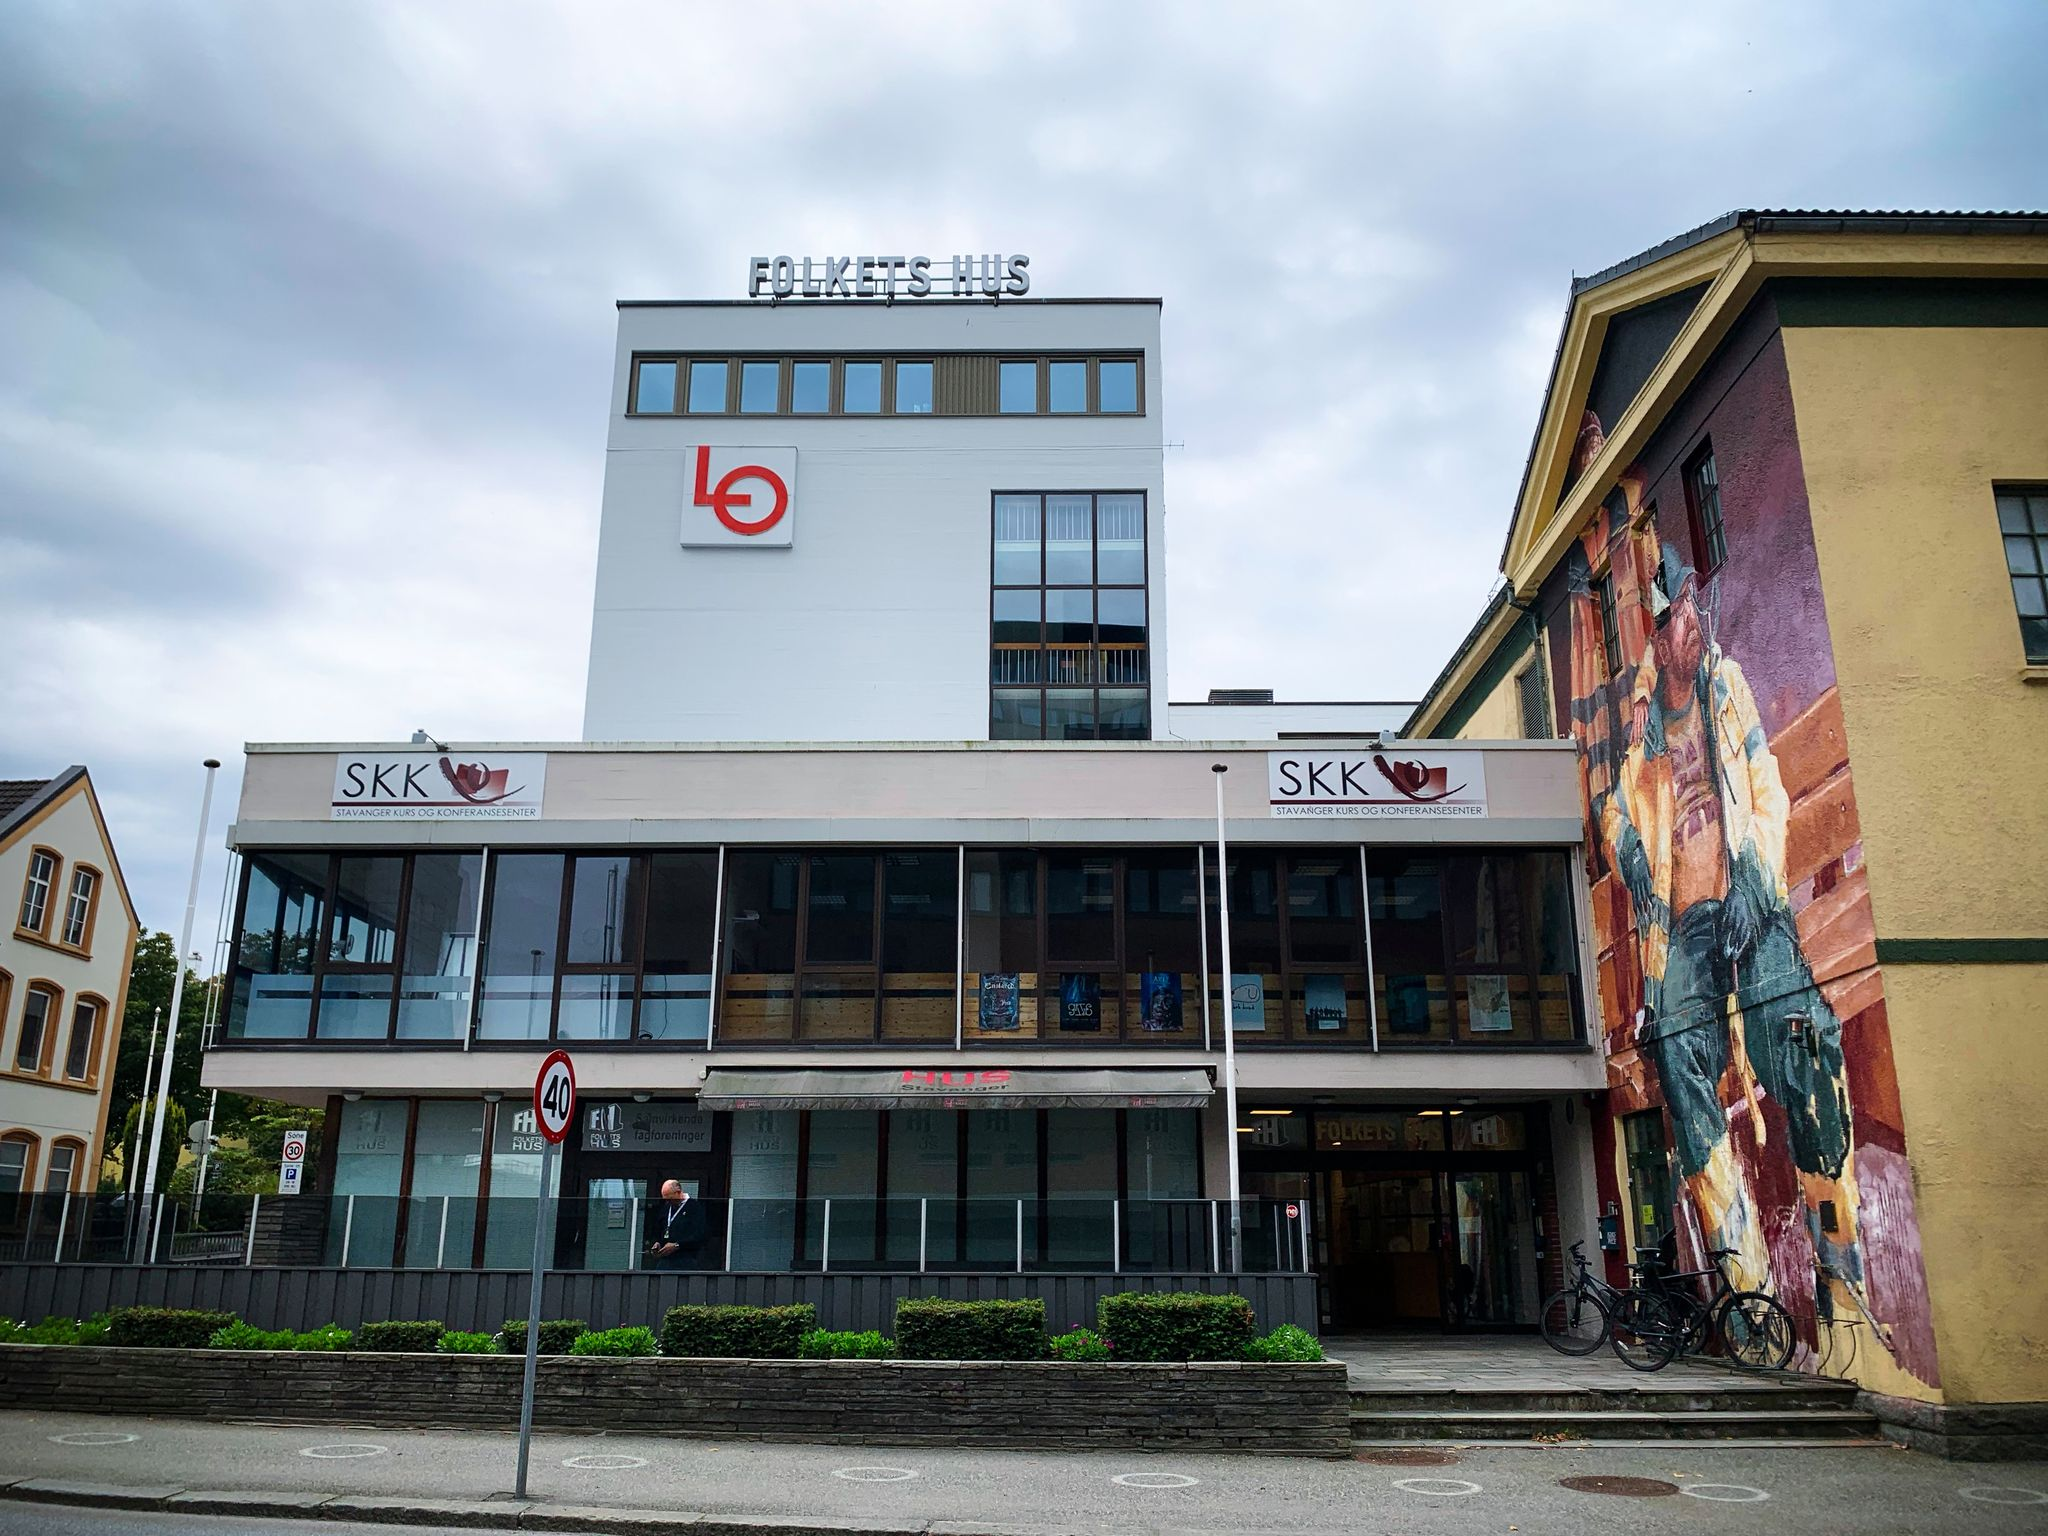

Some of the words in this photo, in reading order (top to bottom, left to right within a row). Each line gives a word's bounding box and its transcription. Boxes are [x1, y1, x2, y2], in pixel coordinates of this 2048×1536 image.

[748, 255, 932, 298] FOLKETS
[951, 253, 1030, 297] HUS
[693, 445, 789, 536] LO
[342, 762, 432, 798] SKK
[1278, 759, 1370, 796] SKK
[336, 808, 392, 817] STAVANGER
[393, 808, 416, 817] KURS
[417, 808, 435, 817] OG
[437, 808, 536, 817] KONFERANSESENTER
[1276, 806, 1333, 815] STAVANGER
[1336, 806, 1359, 815] KURS
[1361, 806, 1379, 815] OG
[1381, 806, 1483, 815] KONFERANSESENTER
[902, 1069, 1012, 1086] HUS
[542, 1074, 571, 1121] 40
[634, 1130, 705, 1143] fagforeninger
[1316, 1120, 1396, 1142] FOLKETS
[288, 1146, 300, 1155] 30
[512, 1142, 543, 1151] HUS
